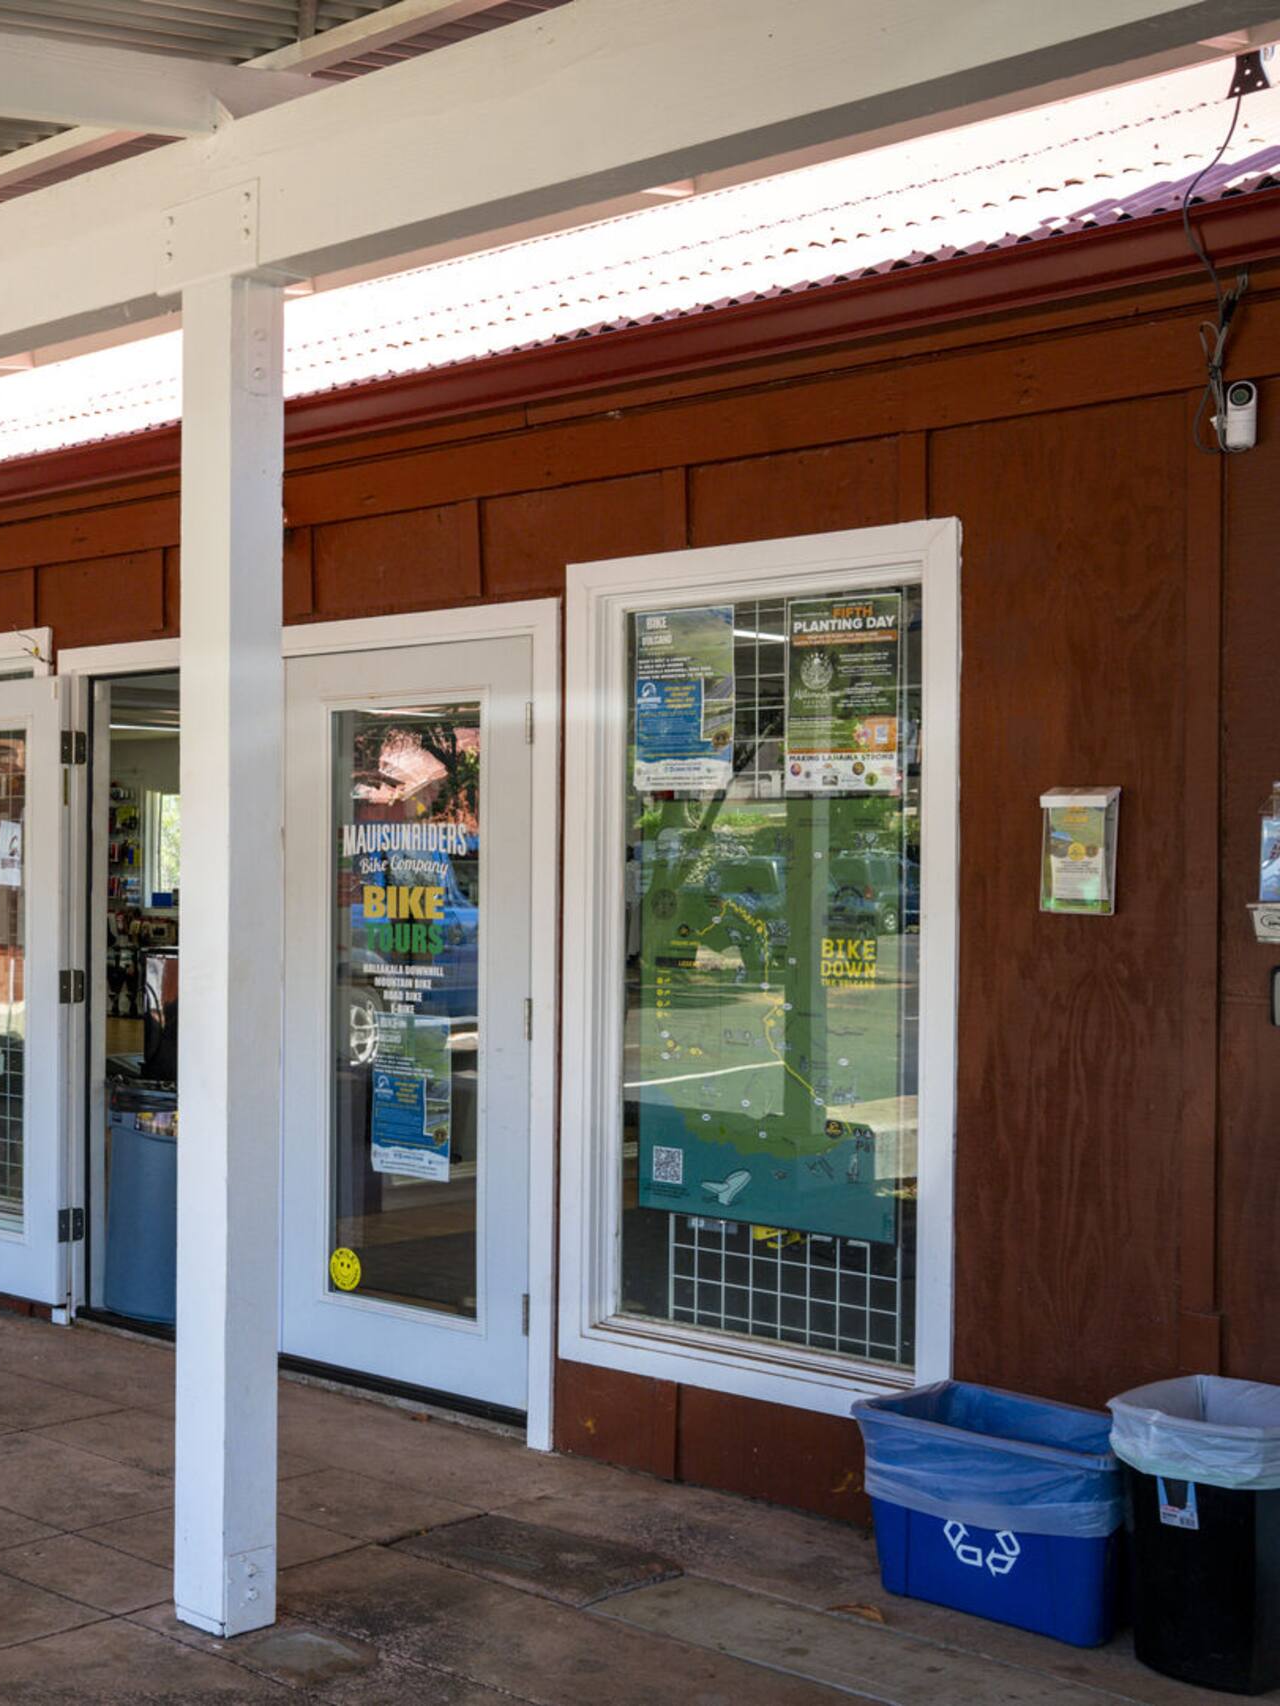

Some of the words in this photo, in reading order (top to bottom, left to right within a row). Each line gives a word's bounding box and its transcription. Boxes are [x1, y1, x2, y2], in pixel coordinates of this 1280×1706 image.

[832, 605, 874, 618] FIFTH
[793, 618, 863, 633] PLANTING
[866, 615, 895, 629] DAY
[343, 823, 467, 857] MAUISUNRIDERS
[359, 858, 388, 875] Bike
[390, 855, 448, 877] Company
[363, 885, 445, 919] BIKE
[364, 923, 445, 955] TOURS
[821, 938, 877, 960] BIKE
[821, 960, 877, 978] DOWN
[374, 976, 413, 989] MOUNTAIN
[415, 979, 433, 990] BIKE
[405, 991, 423, 1003] BIKE
